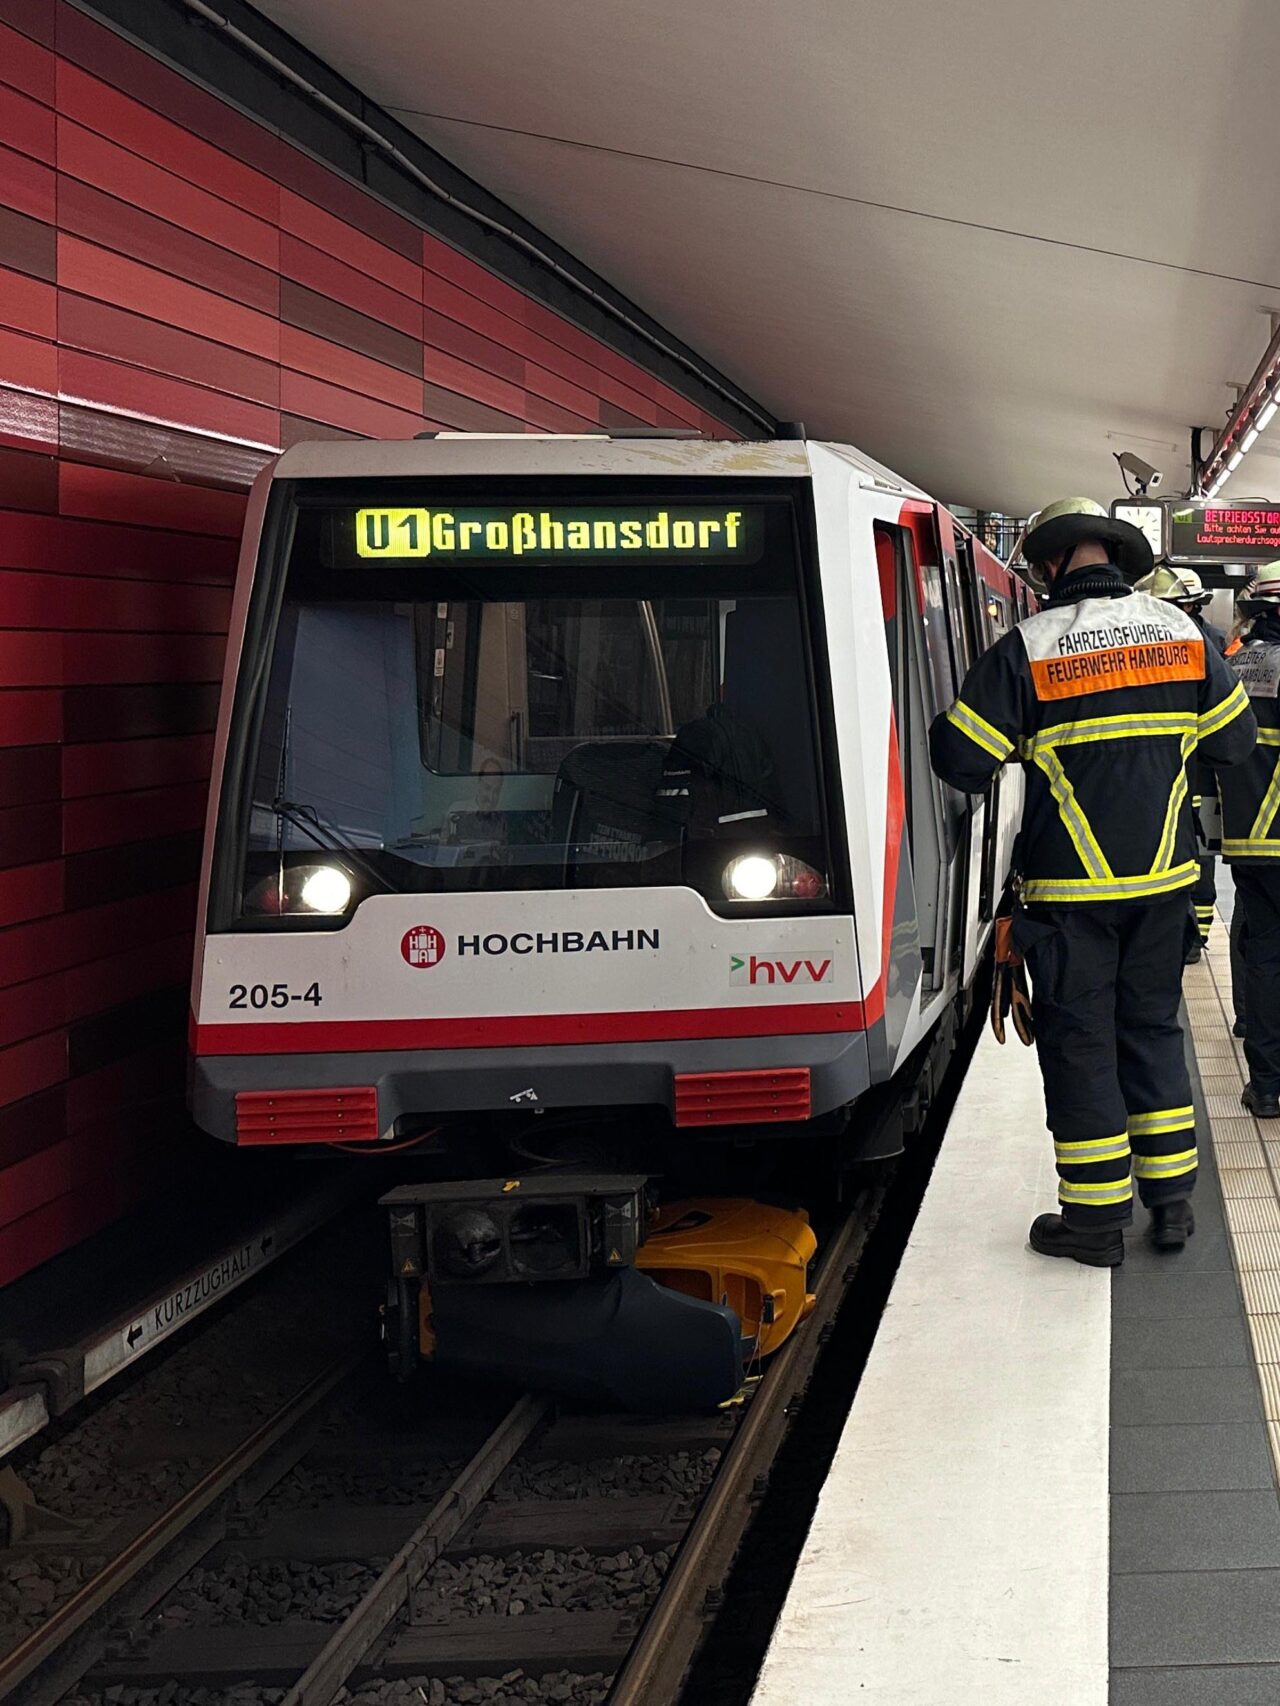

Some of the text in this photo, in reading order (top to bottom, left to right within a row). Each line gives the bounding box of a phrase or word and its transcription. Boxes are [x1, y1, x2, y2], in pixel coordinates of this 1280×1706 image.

[366, 512, 742, 555] U1 Großhansdorf
[1204, 525, 1223, 533] Bitte
[1227, 525, 1251, 534] achten
[1255, 525, 1267, 534] Sie
[1058, 622, 1172, 655] FAHRZEUGFÜHRER
[1046, 645, 1188, 684] FEUERWEHR HAMBURG
[458, 929, 660, 955] HOCHBAHN
[749, 954, 832, 984] hvv
[228, 982, 322, 1009] 205-4
[154, 1246, 251, 1331] KURZZUGHALT
